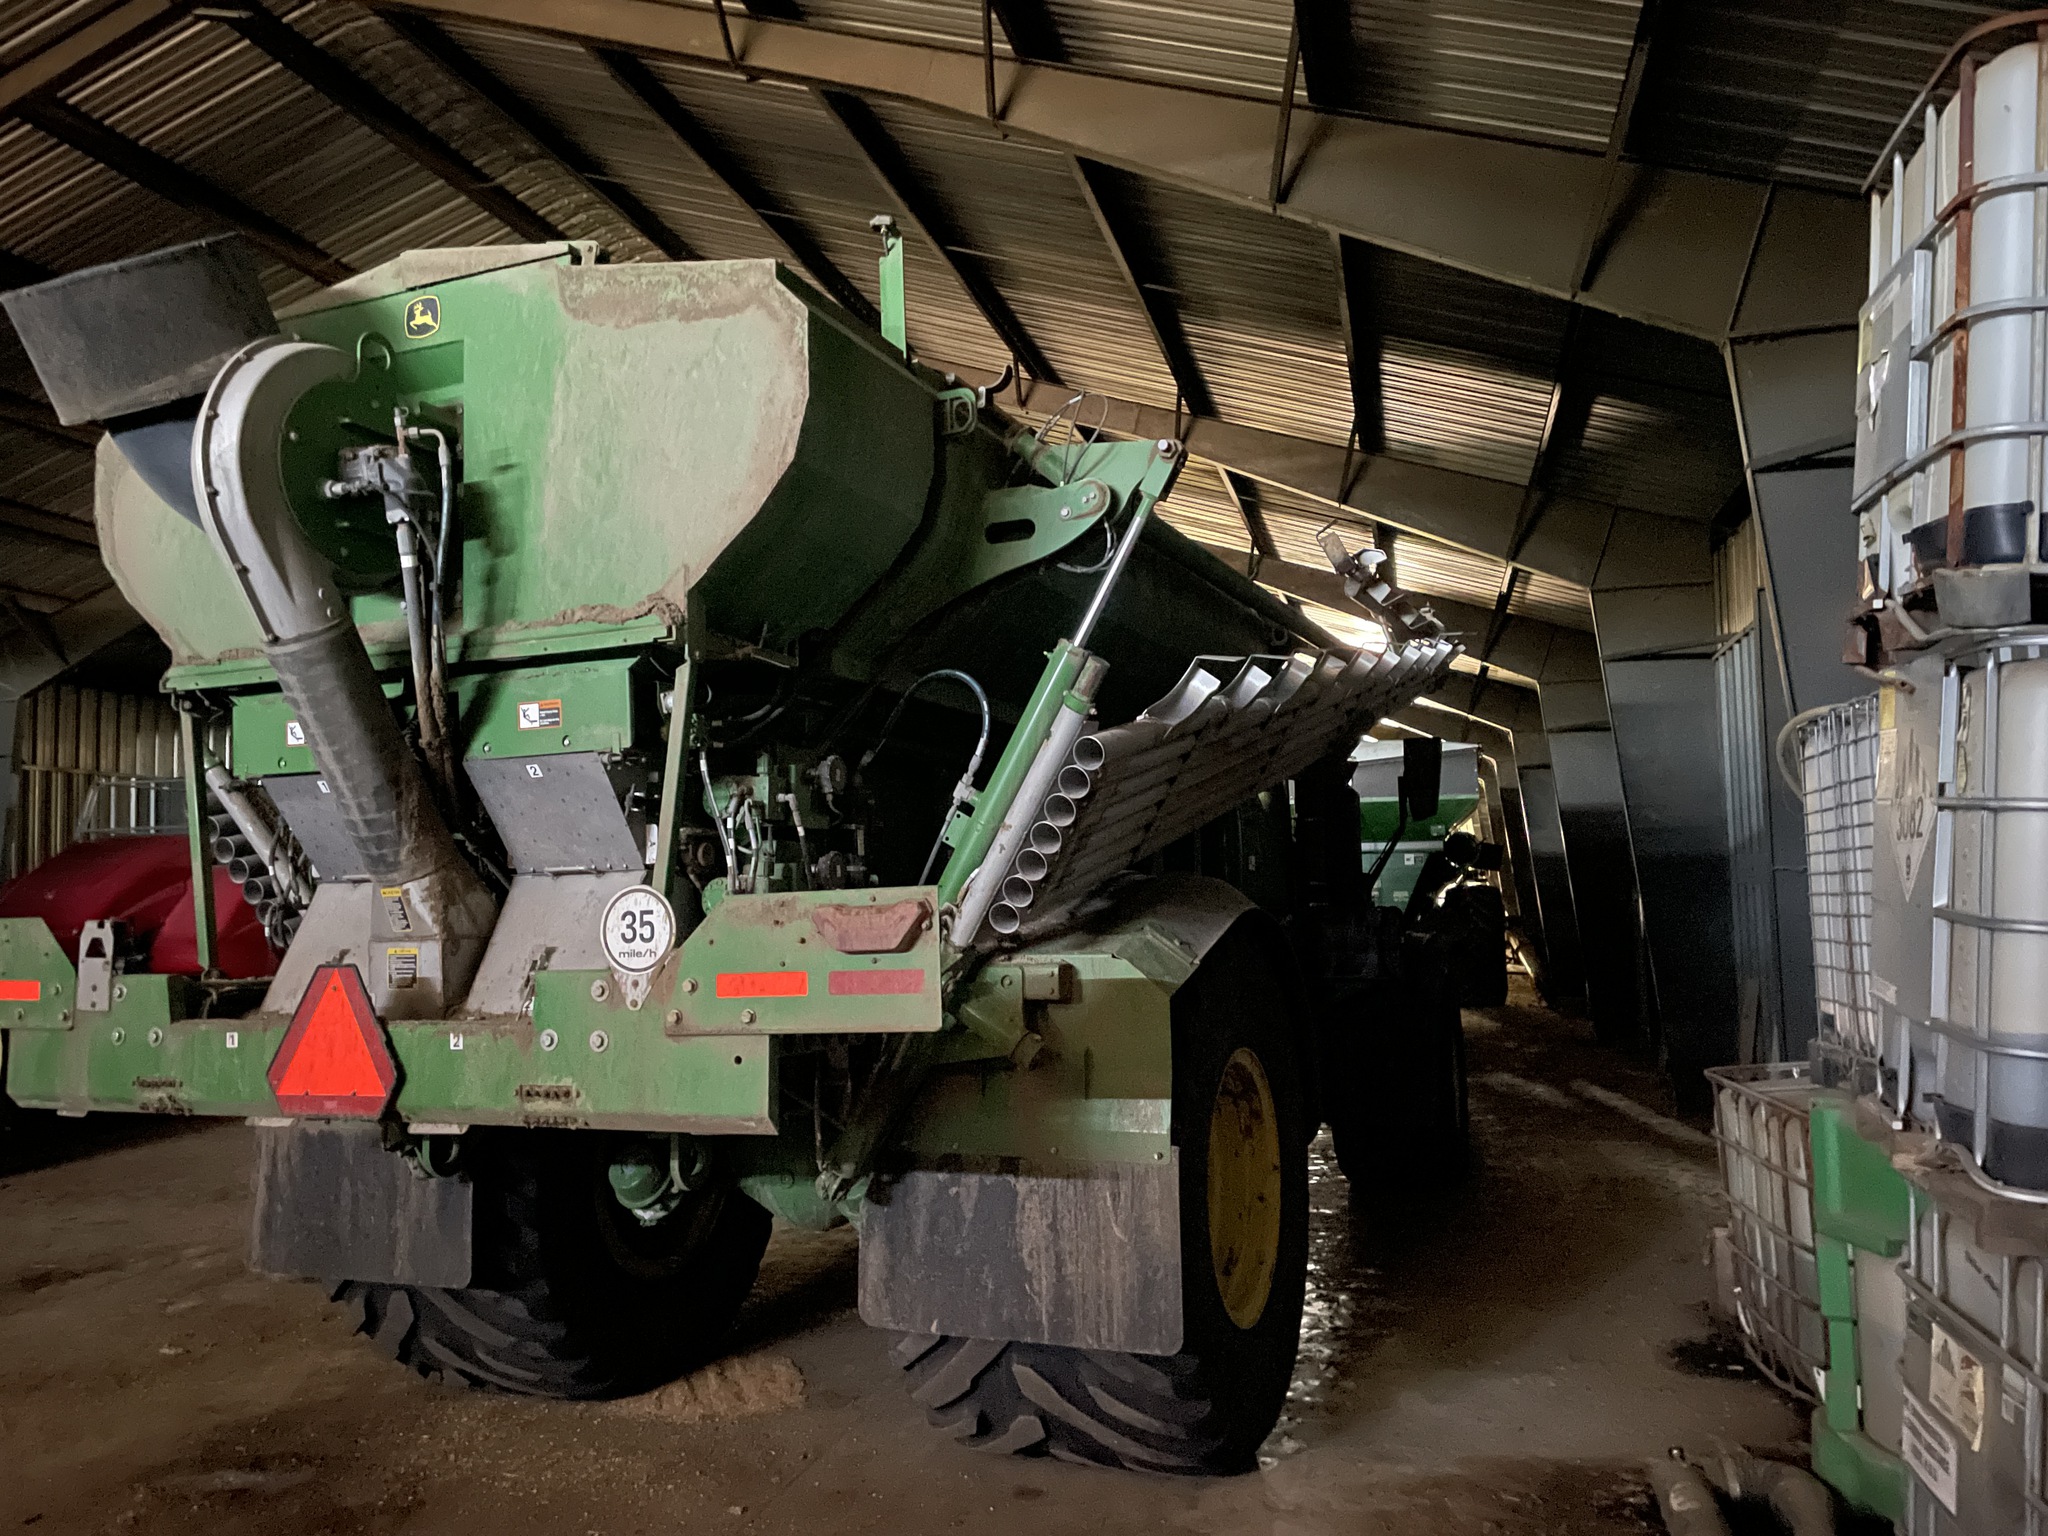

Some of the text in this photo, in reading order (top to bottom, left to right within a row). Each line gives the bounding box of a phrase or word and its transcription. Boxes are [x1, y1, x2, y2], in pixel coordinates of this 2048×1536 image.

[530, 766, 539, 776] 2
[620, 910, 655, 944] 35
[618, 949, 657, 958] mile/h
